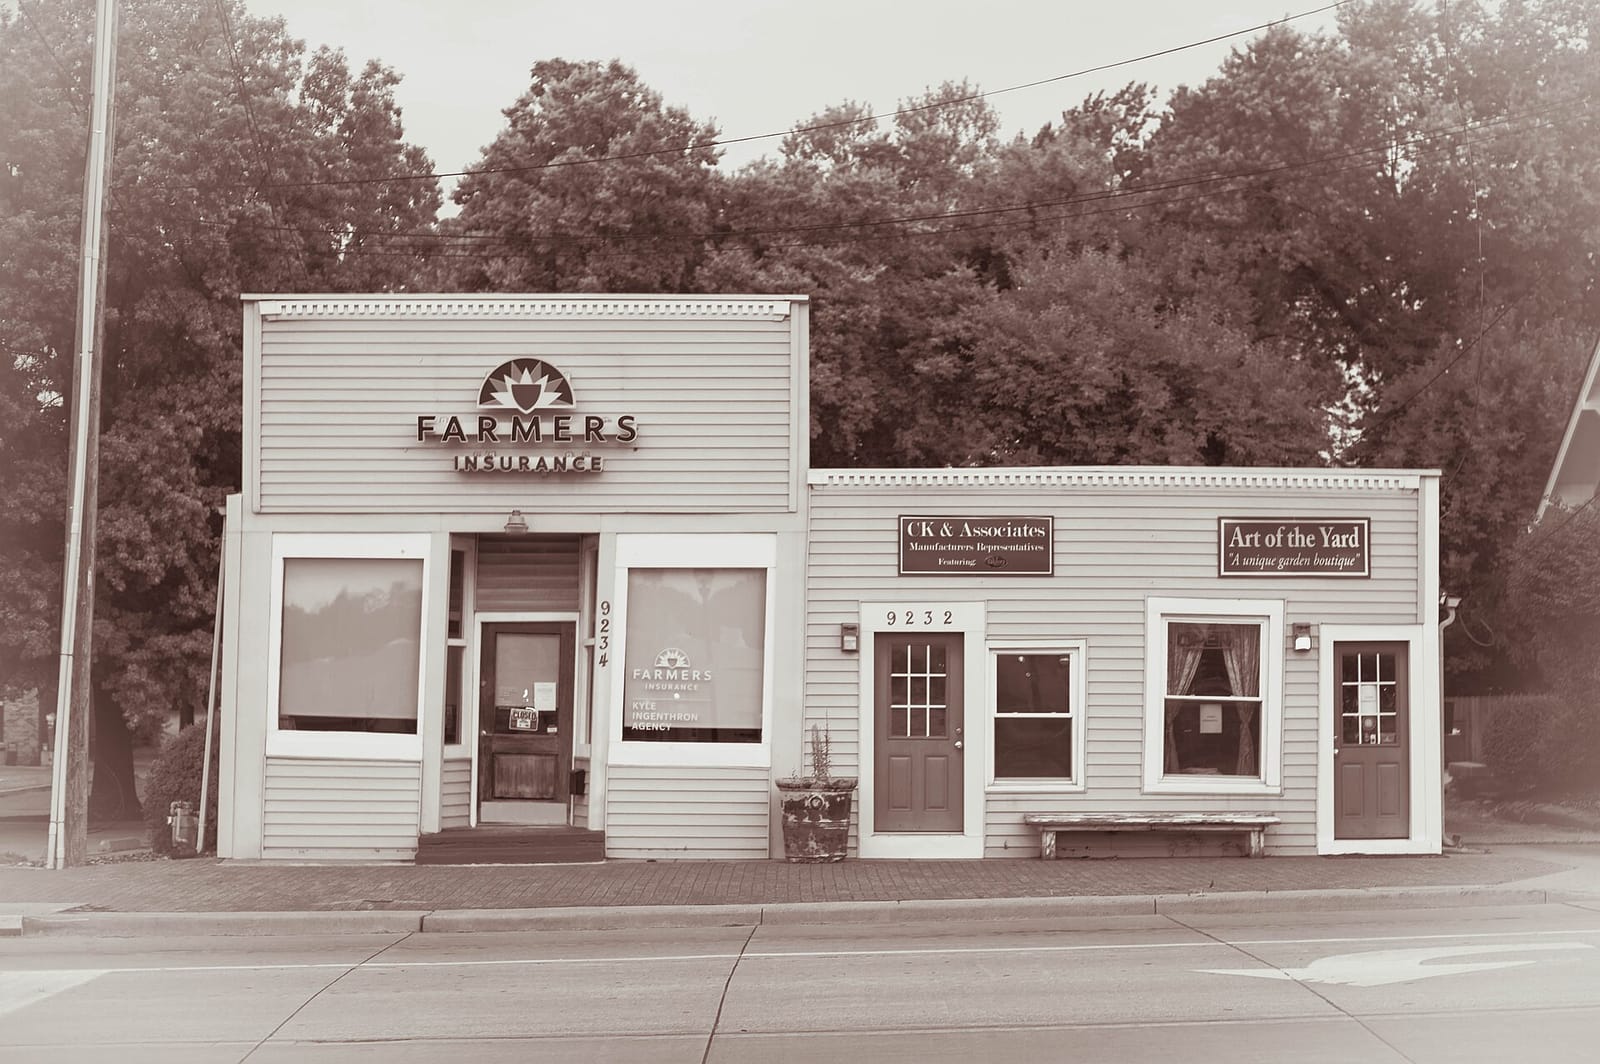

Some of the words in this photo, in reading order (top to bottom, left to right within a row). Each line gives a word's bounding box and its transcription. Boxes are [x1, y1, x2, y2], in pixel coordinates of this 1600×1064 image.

[417, 415, 638, 442] FARMERS
[454, 455, 603, 472] INSURANCE
[907, 521, 935, 537] CK
[940, 522, 953, 537] &
[959, 521, 1046, 538] Associates
[1228, 526, 1261, 547] Art
[1264, 526, 1285, 547] of
[1287, 526, 1316, 547] the
[1319, 526, 1360, 547] Yard
[909, 542, 975, 551] Manufacturers
[977, 542, 1044, 553] Representatives
[938, 558, 977, 567] Featuring
[1242, 554, 1277, 570] unique
[1278, 553, 1310, 569] garden
[887, 610, 953, 625] 9232
[598, 600, 610, 667] 9234
[633, 669, 712, 681] FARMERS
[645, 683, 699, 691] INSURANCE
[632, 702, 657, 710] KYLE
[632, 712, 698, 721] INGENTHRON
[631, 722, 672, 731] AGENCY
